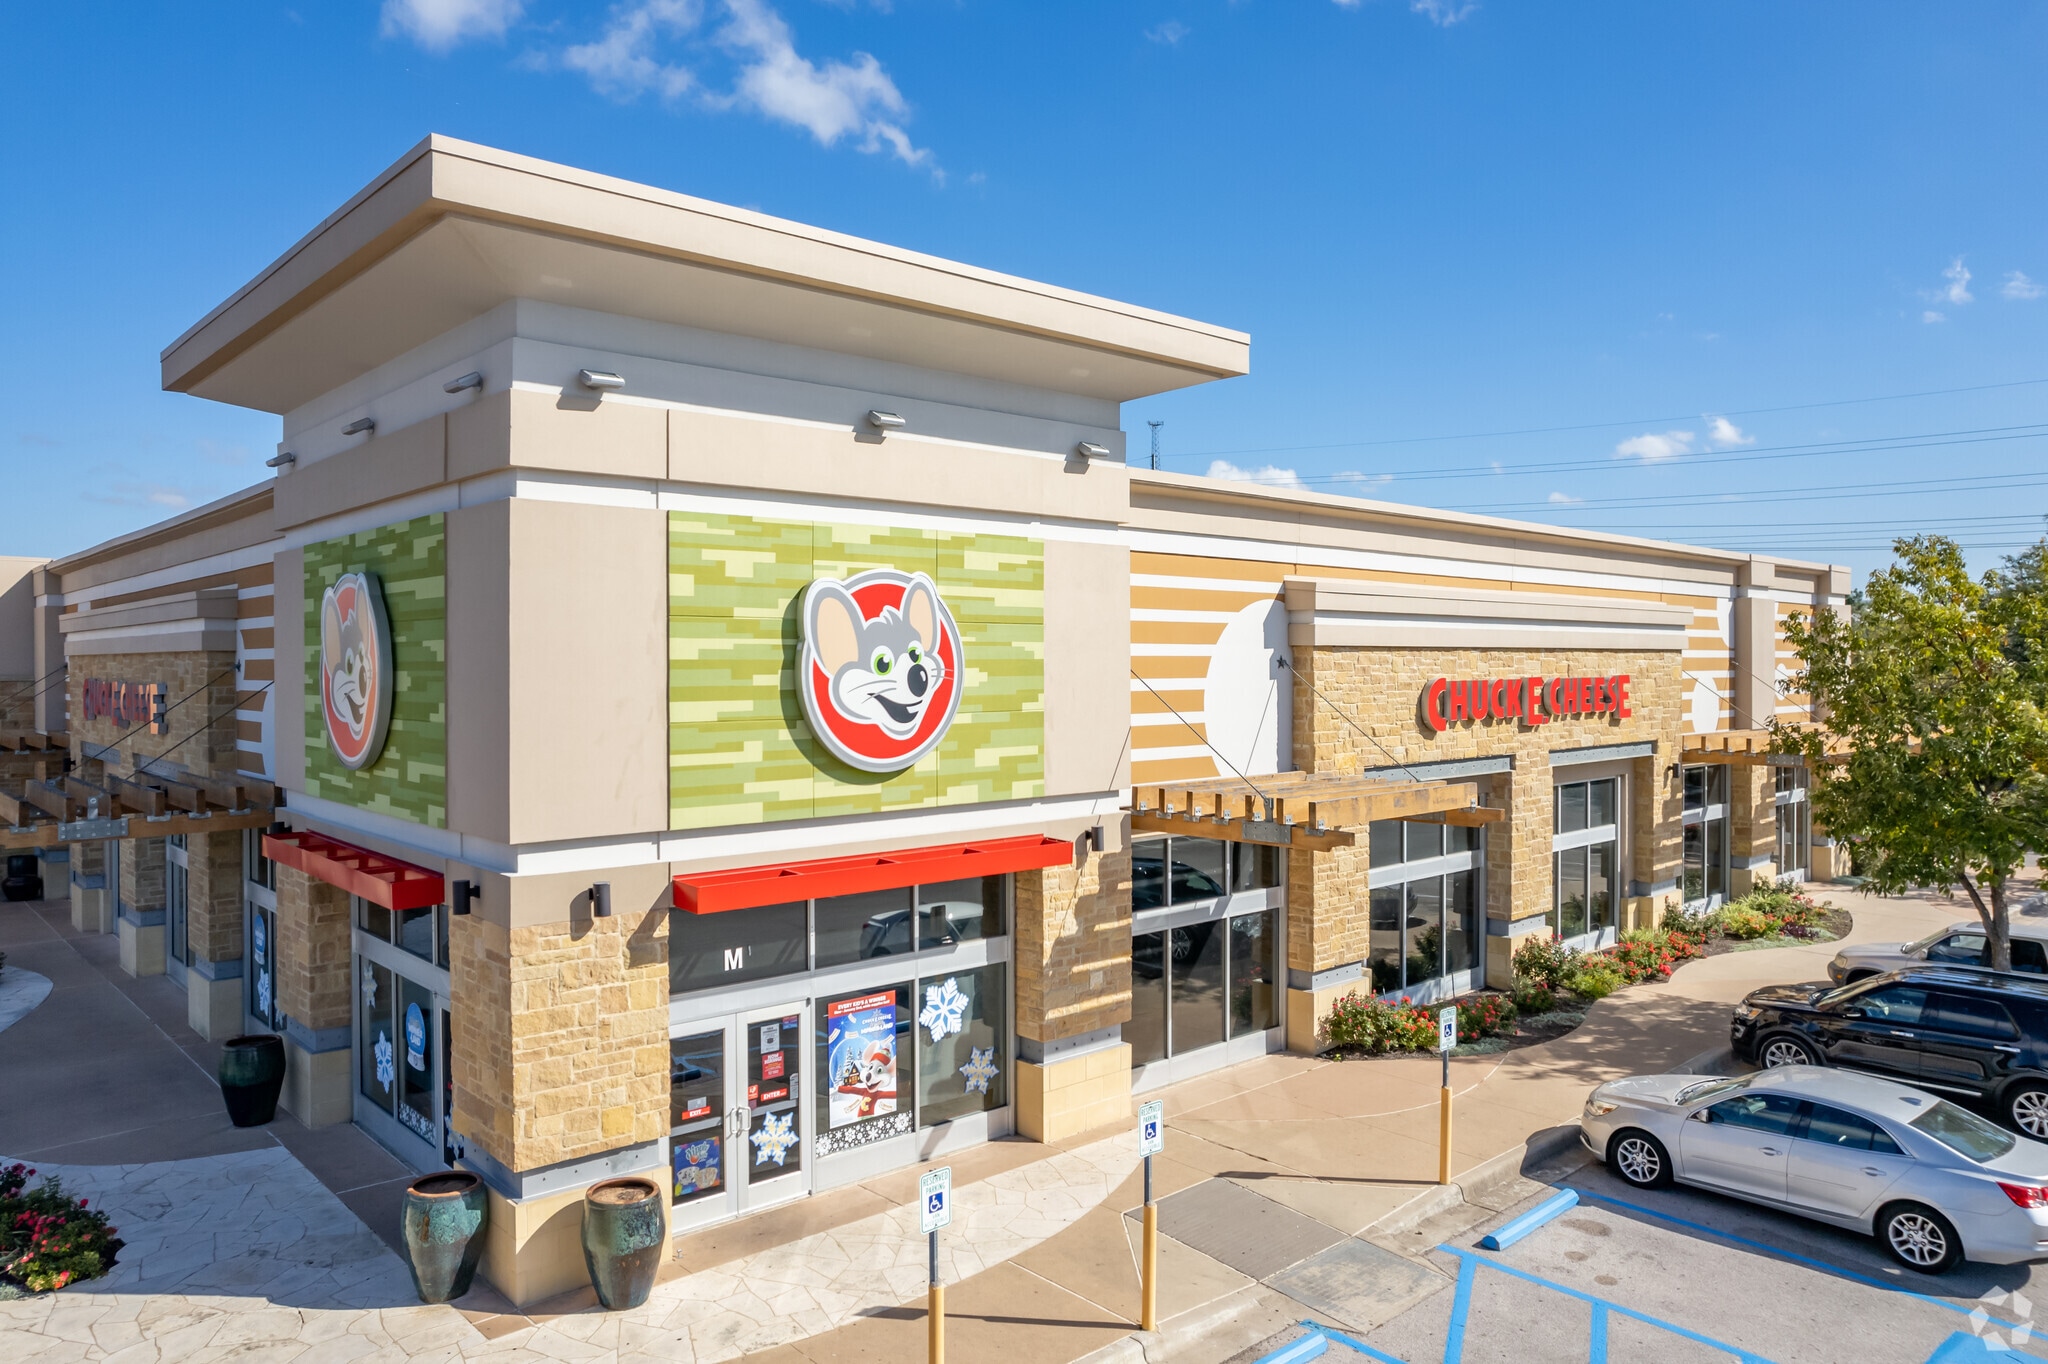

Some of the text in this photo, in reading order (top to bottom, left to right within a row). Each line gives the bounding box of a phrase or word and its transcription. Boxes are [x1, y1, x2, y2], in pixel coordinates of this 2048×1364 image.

[1422, 677, 1523, 731] CHUCK
[1545, 674, 1632, 719] CHEESE
[724, 946, 743, 972] M
[1141, 1104, 1161, 1116] RESERVED
[1143, 1113, 1158, 1123] PARKING
[923, 1171, 948, 1187] RESERVED
[925, 1182, 946, 1195] PARKING
